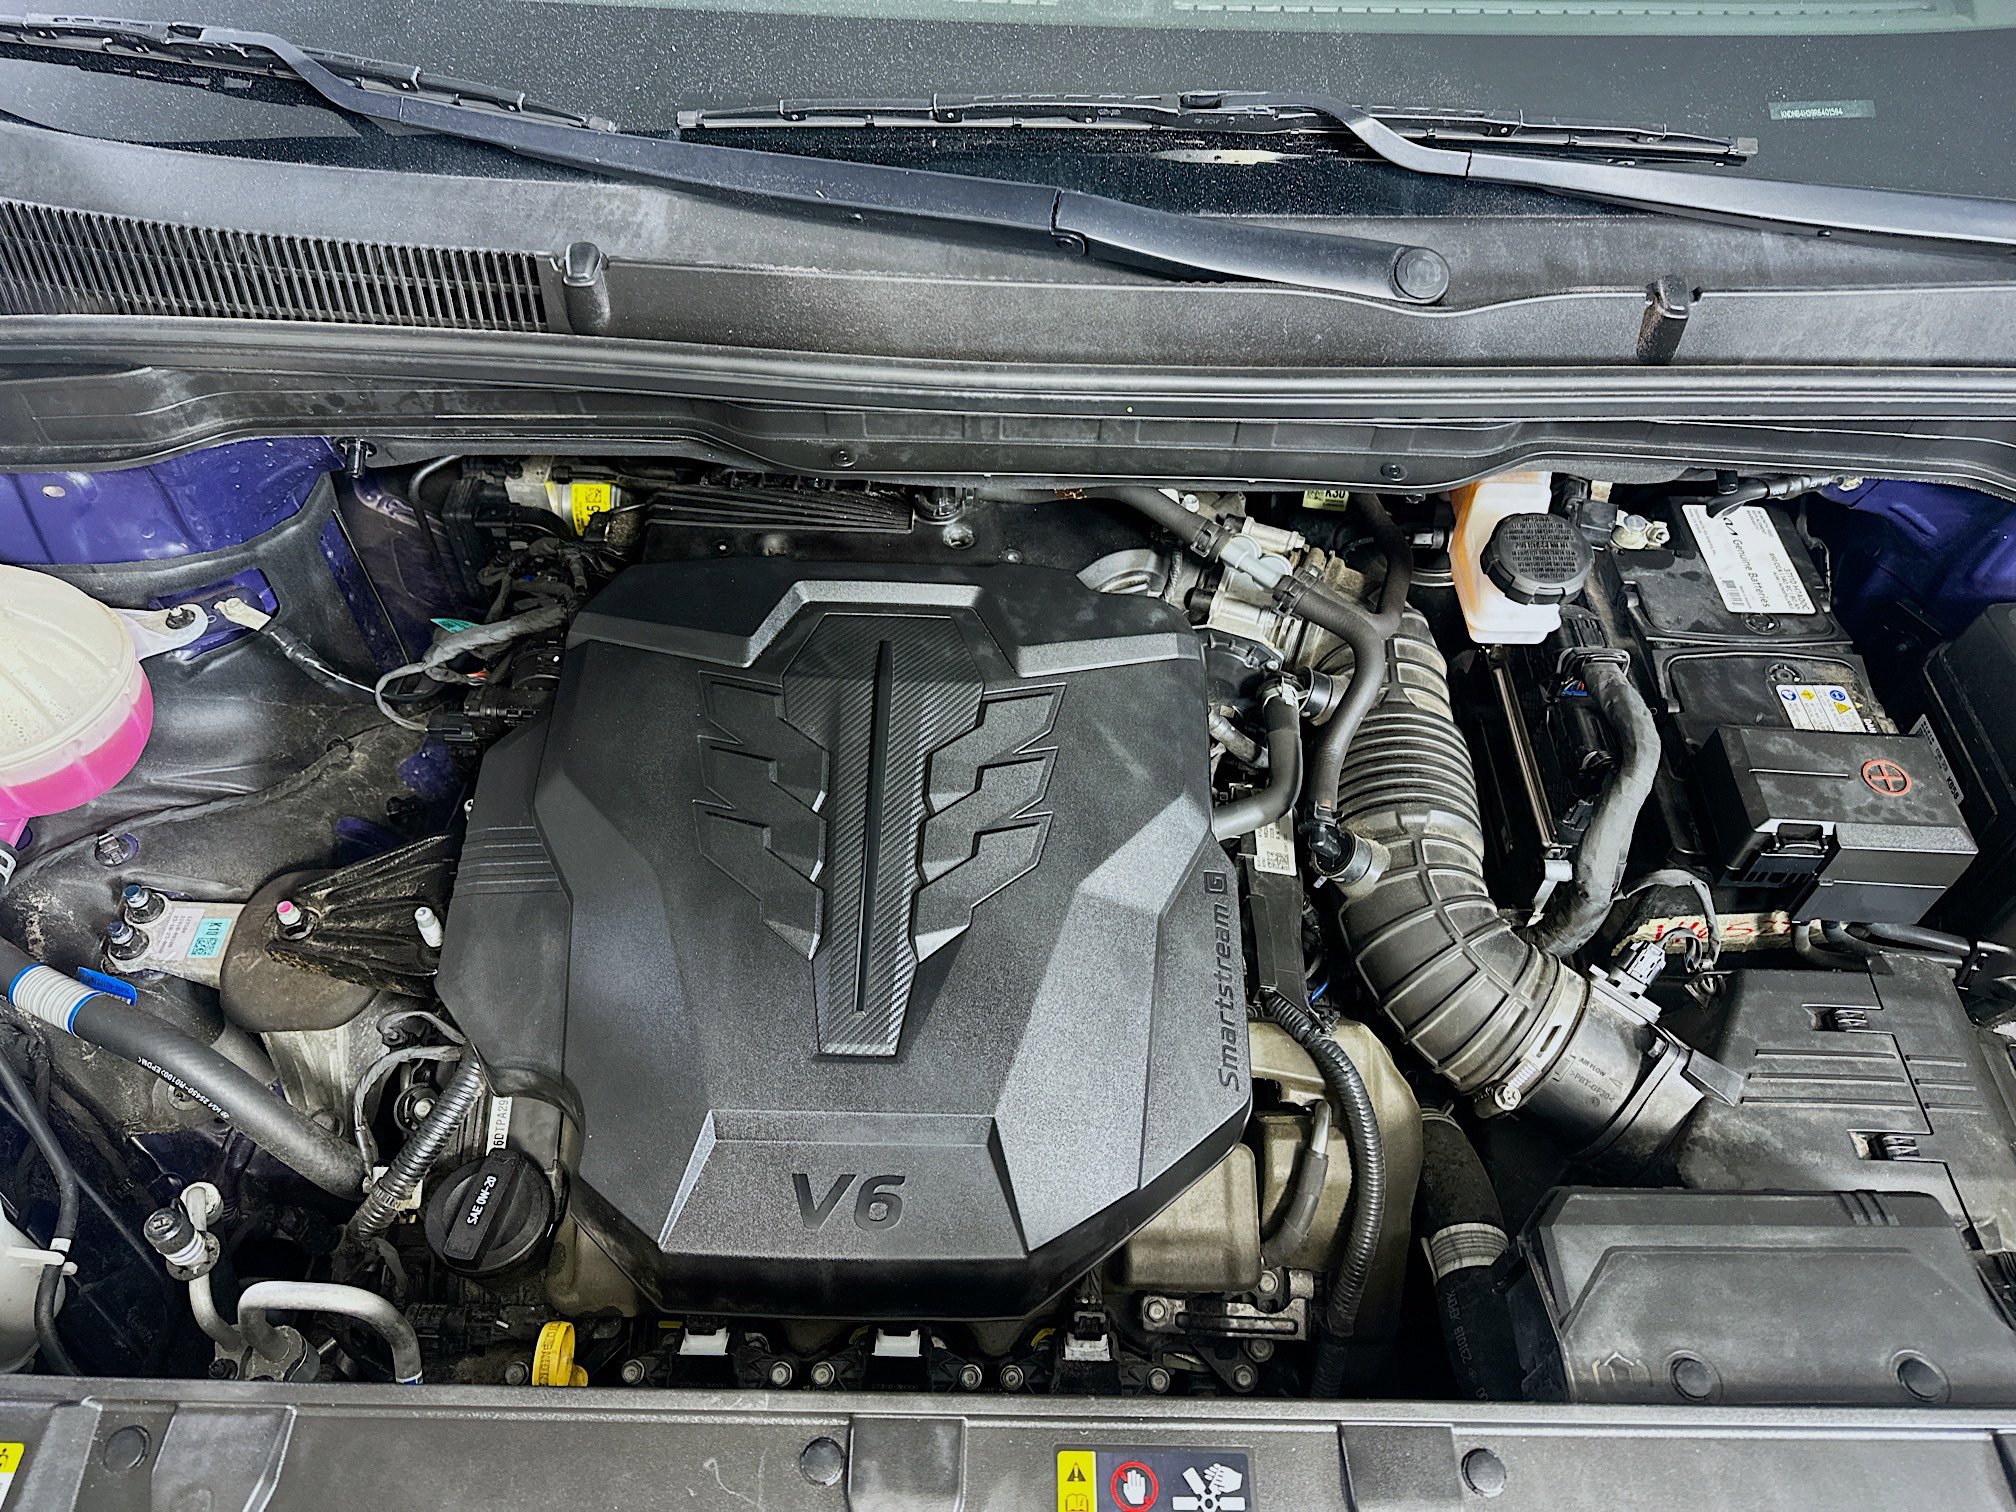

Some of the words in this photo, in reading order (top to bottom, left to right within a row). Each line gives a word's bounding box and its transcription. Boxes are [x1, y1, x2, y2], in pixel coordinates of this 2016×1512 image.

[1733, 539, 1752, 570] Genuine
[1748, 572, 1769, 607] Batteries
[206, 922, 222, 937] K10
[1214, 902, 1239, 1092] Smartstream
[1579, 1057, 1590, 1067] AIR
[1590, 1063, 1607, 1077] FLOW
[466, 1204, 483, 1226] SAE
[475, 1174, 498, 1206] 0W-20
[792, 1173, 906, 1230] V6
